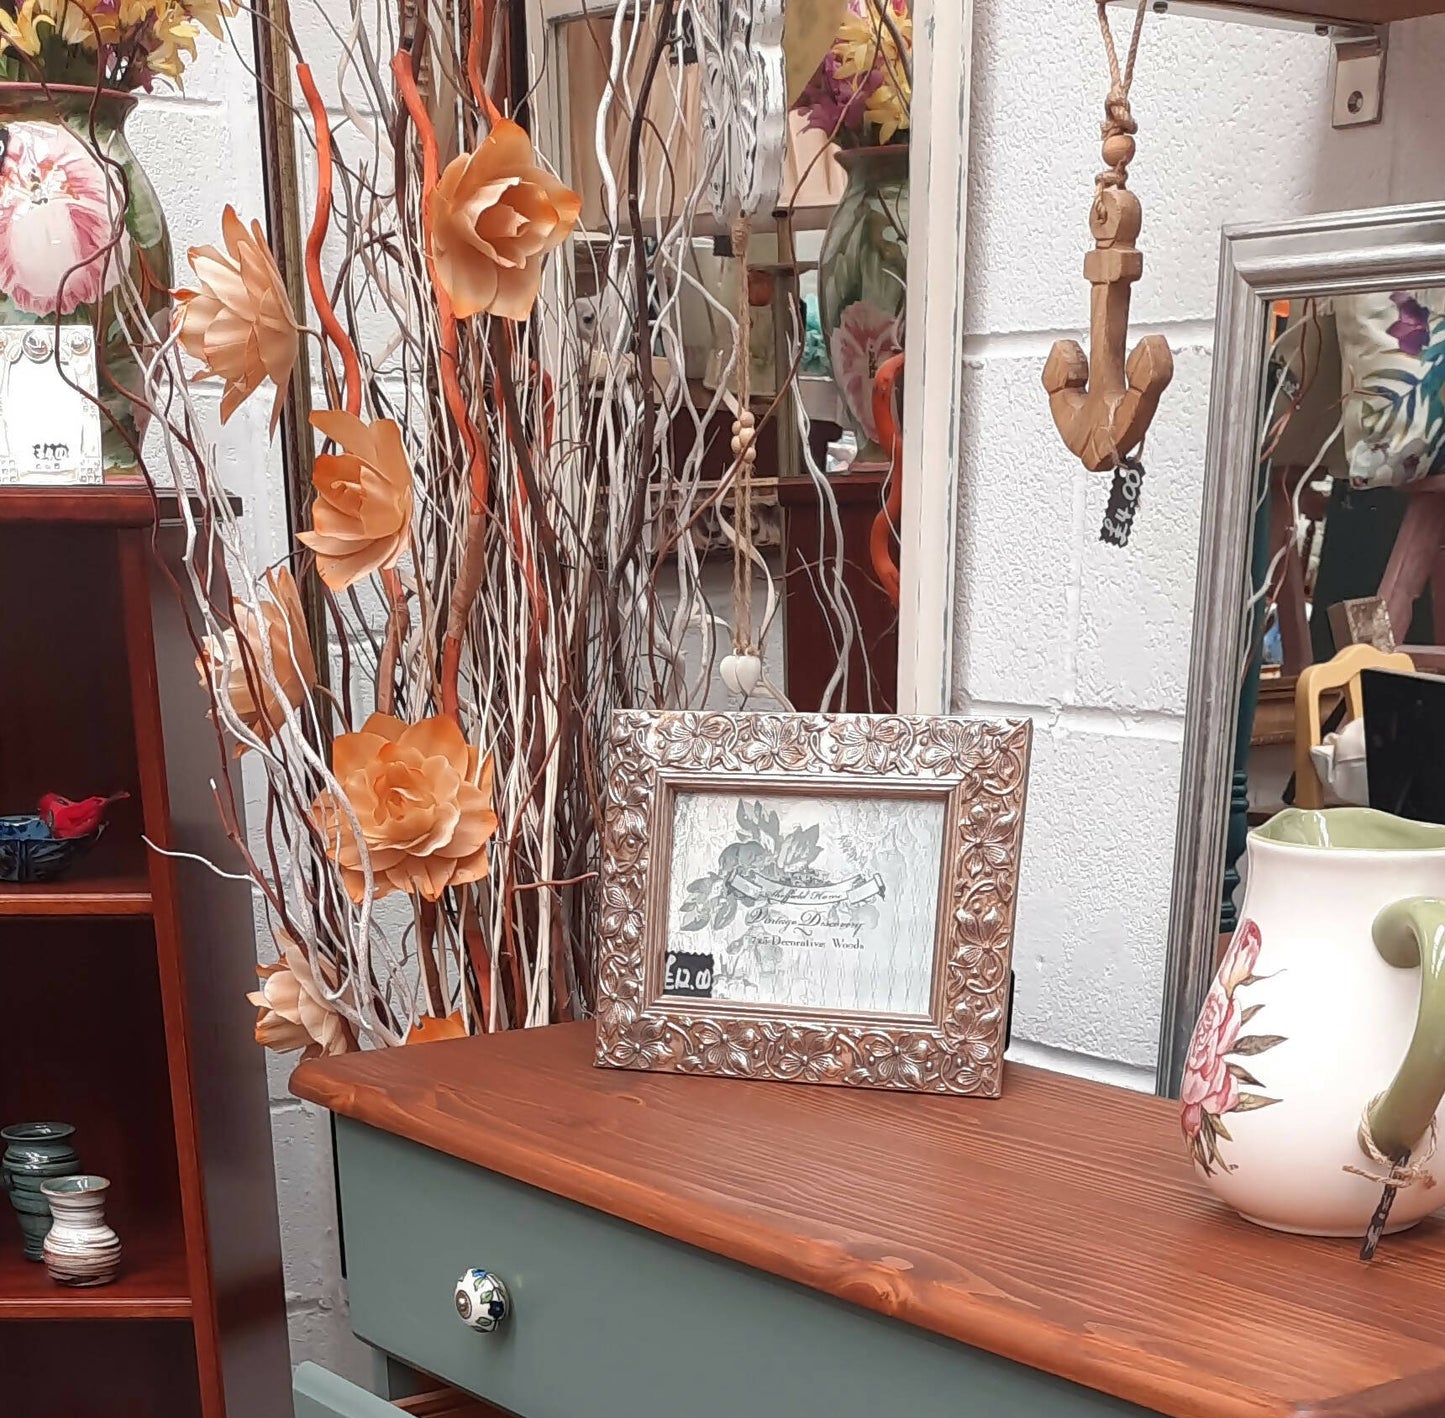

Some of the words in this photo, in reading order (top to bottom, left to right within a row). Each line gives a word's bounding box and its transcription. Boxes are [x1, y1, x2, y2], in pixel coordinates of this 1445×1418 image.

[1104, 469, 1141, 546] £4.00
[746, 907, 798, 933] Vintage
[794, 910, 864, 937] Discovery
[664, 954, 711, 990] £12.00
